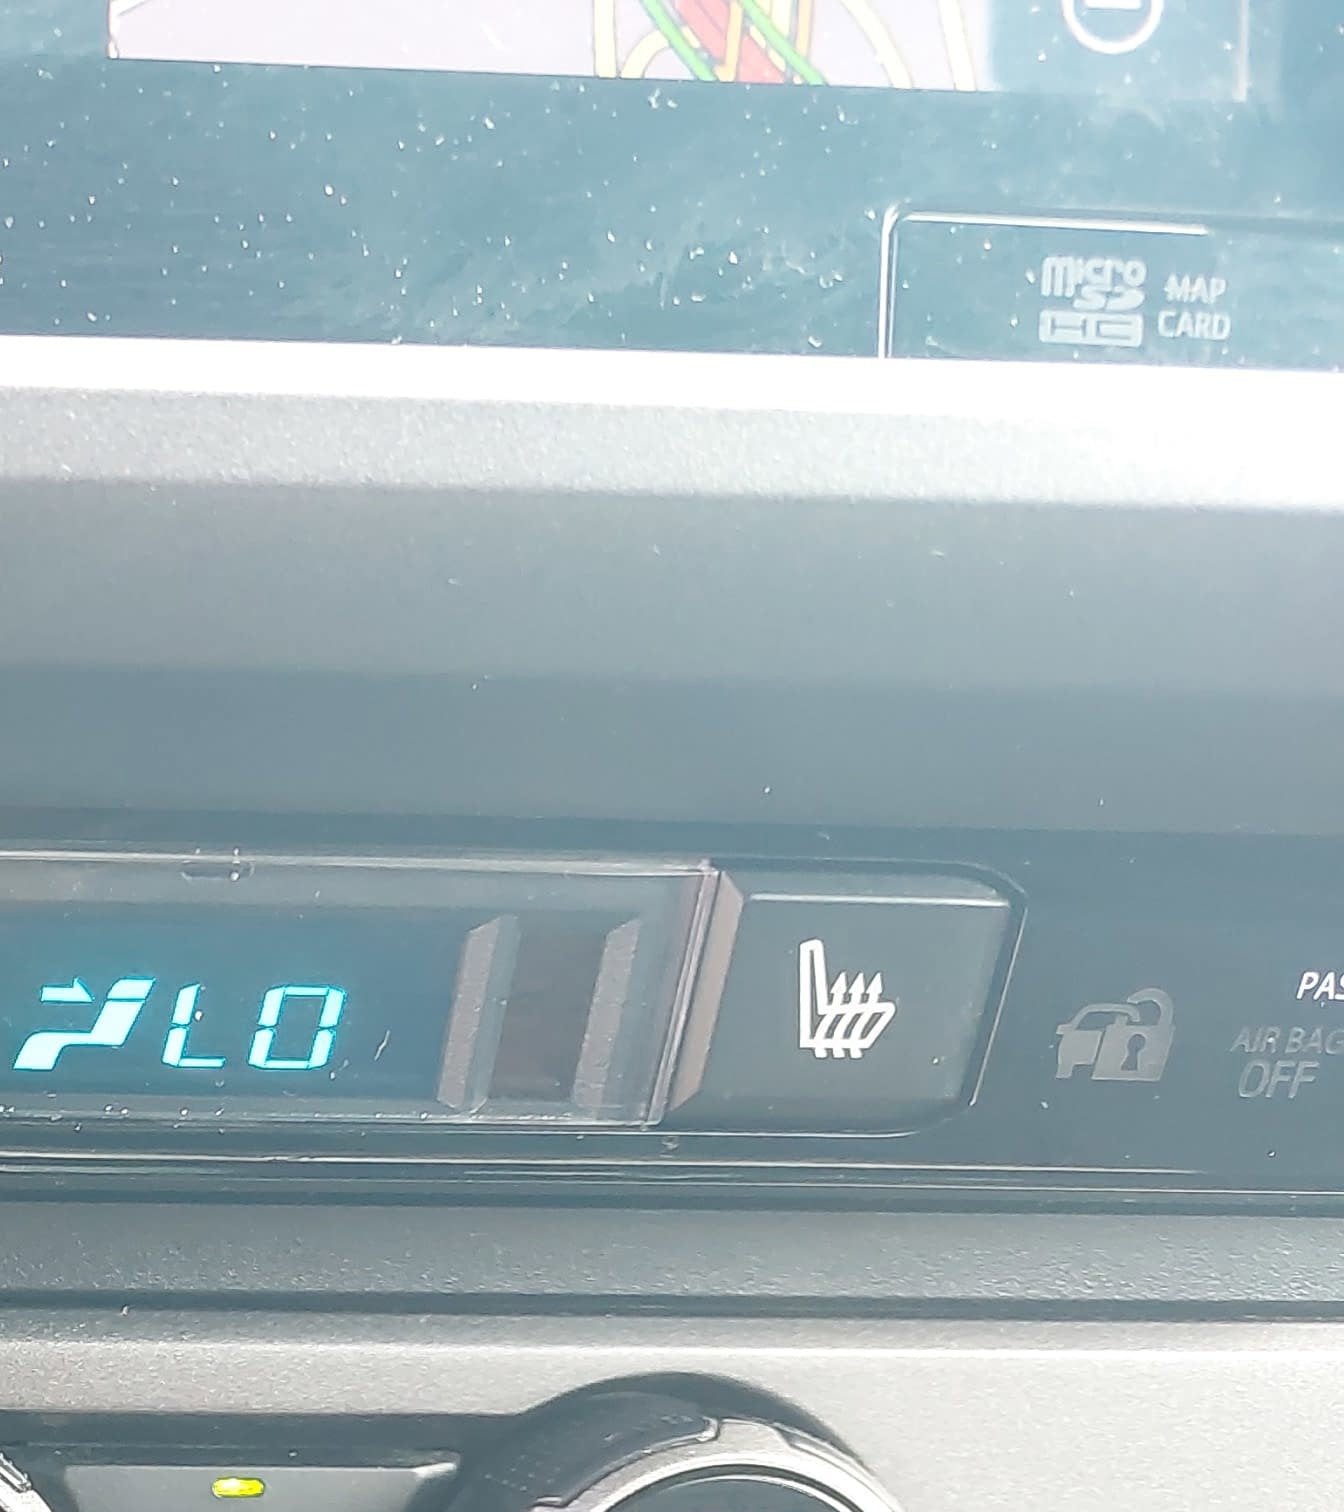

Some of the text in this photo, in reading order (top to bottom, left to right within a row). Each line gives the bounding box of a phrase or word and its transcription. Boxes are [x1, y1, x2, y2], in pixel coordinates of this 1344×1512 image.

[1040, 255, 1148, 298] micro
[1163, 273, 1227, 304] MAP
[1157, 309, 1232, 341] CARD
[1229, 1026, 1282, 1054] AIR
[1238, 1060, 1320, 1099] OFF
